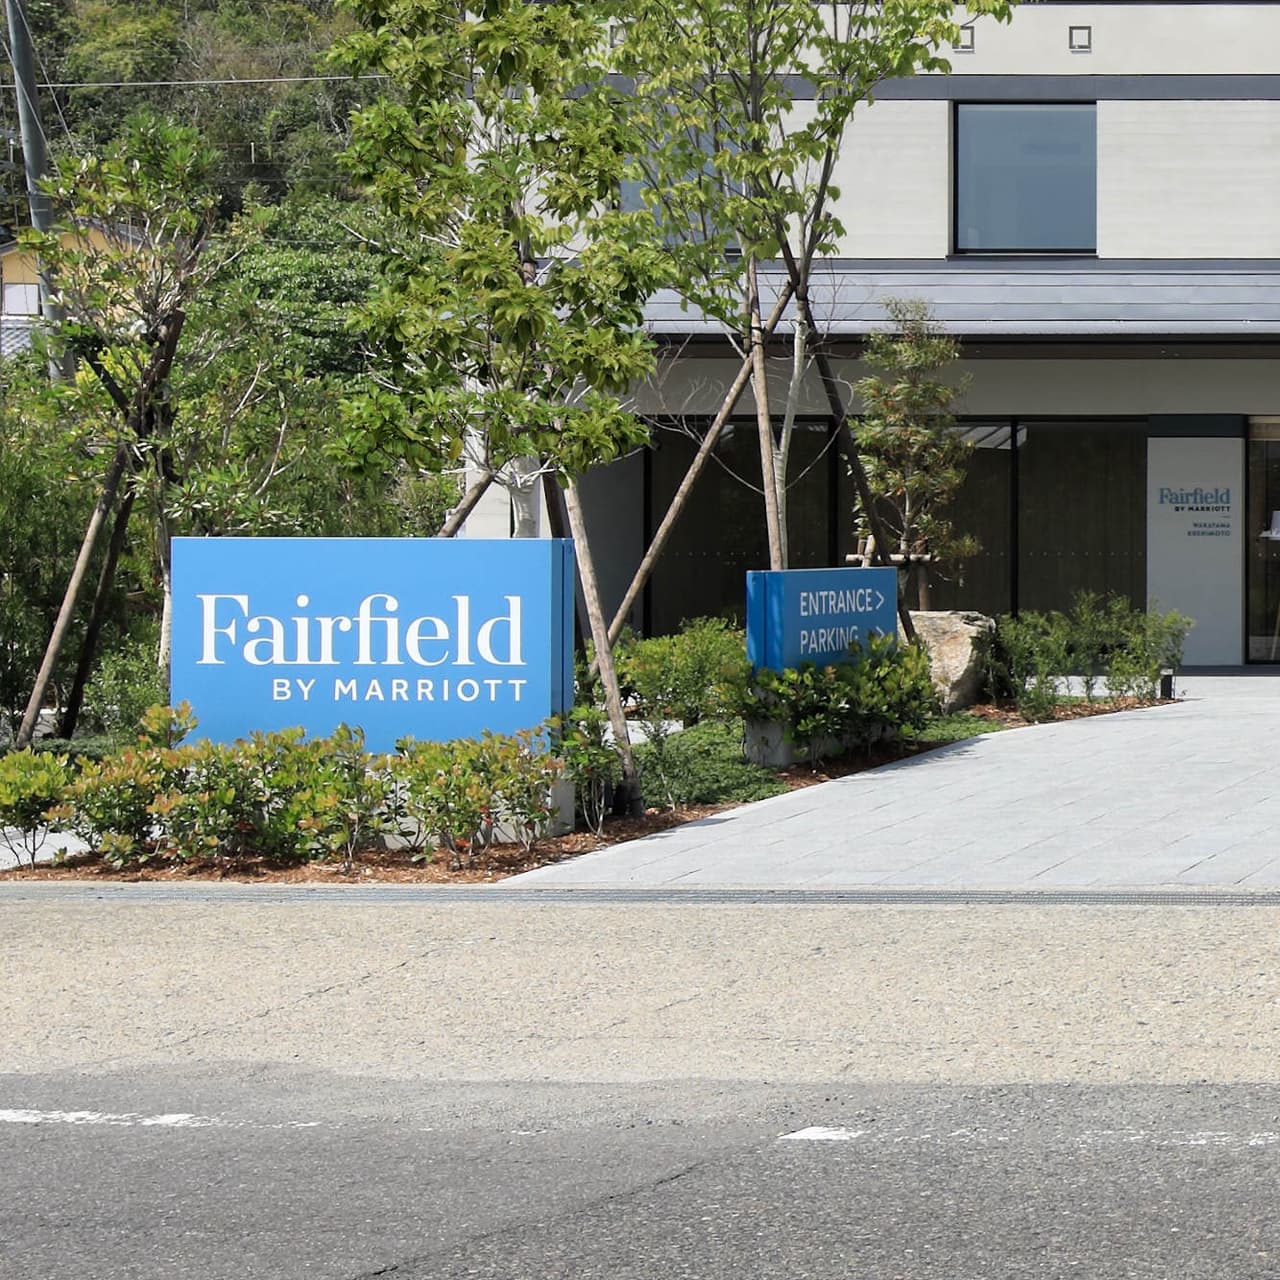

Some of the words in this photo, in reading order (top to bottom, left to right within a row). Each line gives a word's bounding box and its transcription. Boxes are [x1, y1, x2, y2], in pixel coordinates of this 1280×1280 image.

[1159, 488, 1231, 504] Fairfield
[800, 589, 873, 617] ENTRANCE
[196, 593, 527, 666] Fairfield
[272, 679, 316, 701] BY
[334, 678, 528, 702] MARRIOTT
